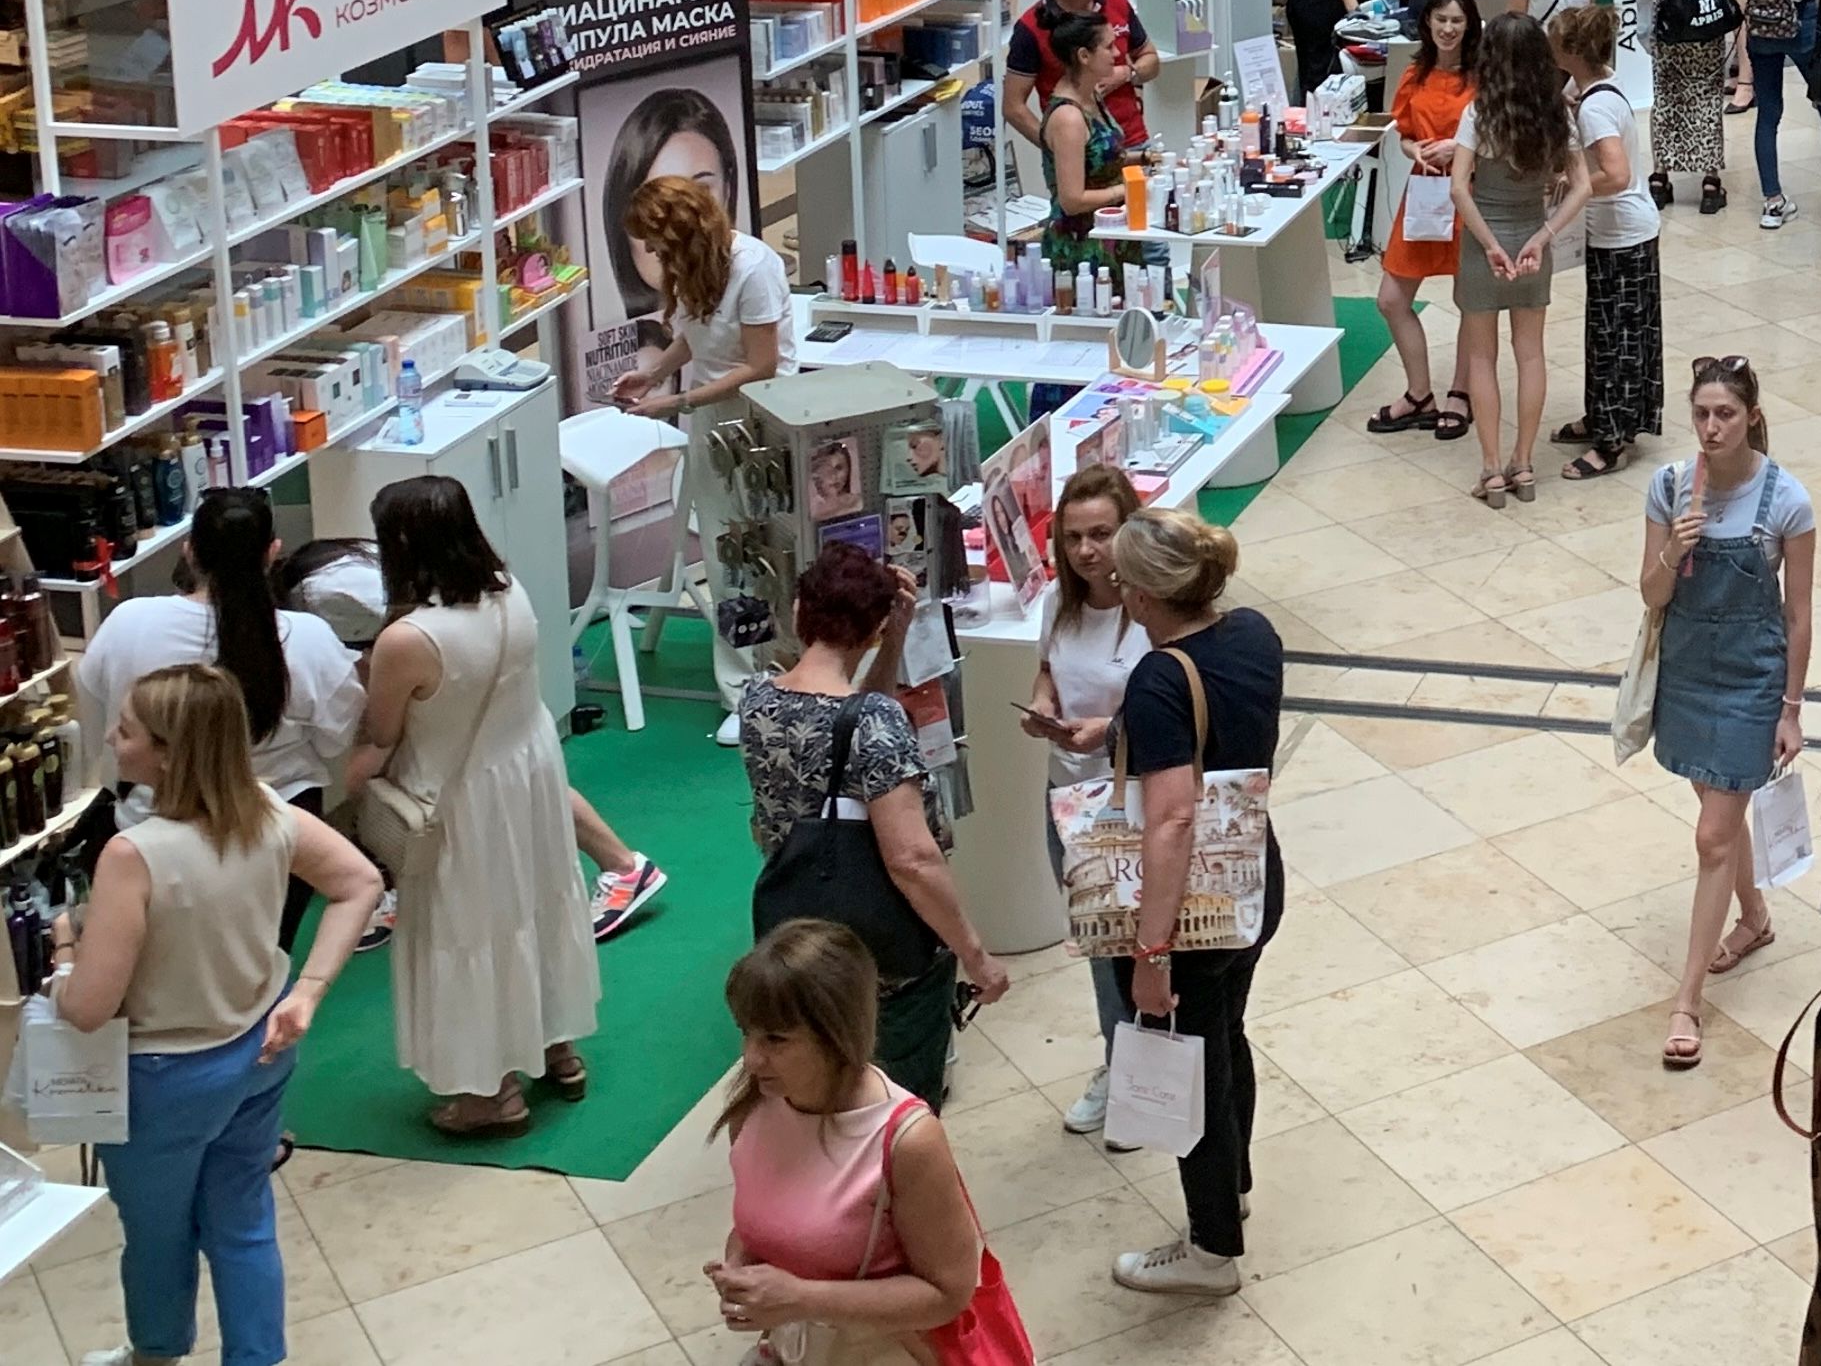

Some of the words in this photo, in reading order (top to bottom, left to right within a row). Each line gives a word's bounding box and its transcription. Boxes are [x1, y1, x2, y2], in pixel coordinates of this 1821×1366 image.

[651, 2, 736, 36] МАСКА
[665, 37, 677, 50] И
[679, 25, 737, 47] СИЯНИЕ
[598, 328, 617, 346] SOFT
[618, 321, 637, 340] SKIN
[585, 337, 638, 368] NUTRITION
